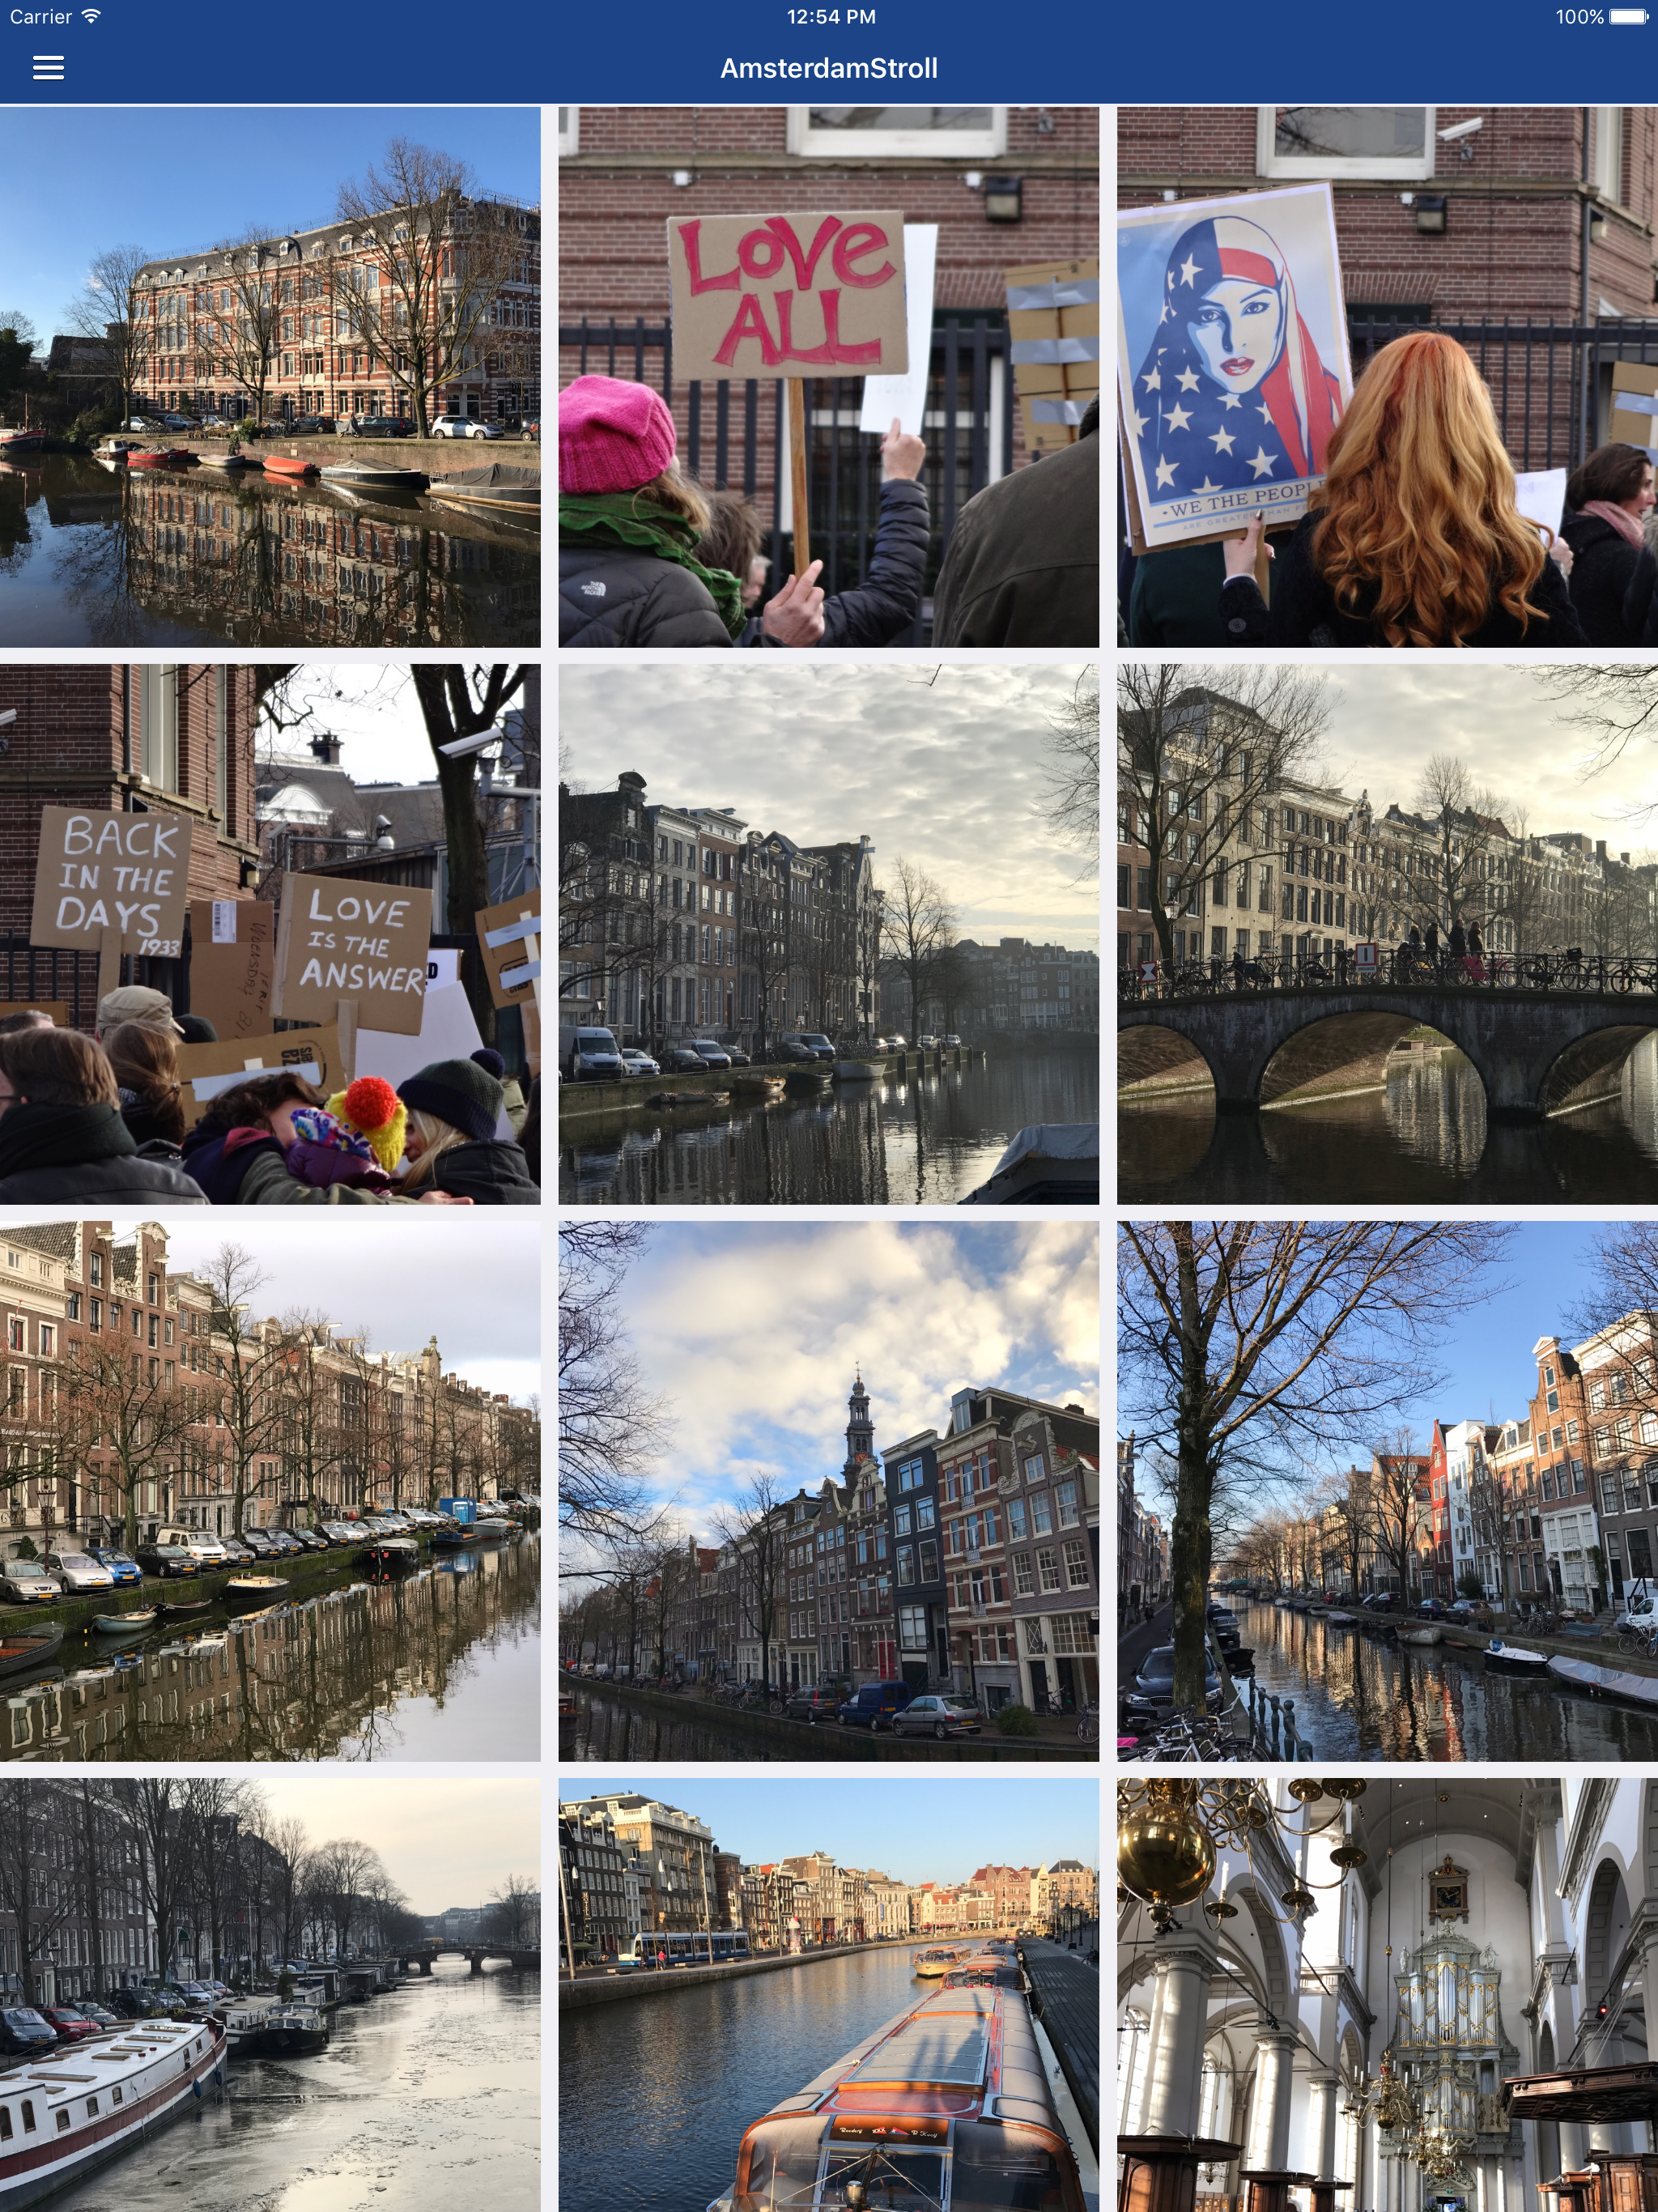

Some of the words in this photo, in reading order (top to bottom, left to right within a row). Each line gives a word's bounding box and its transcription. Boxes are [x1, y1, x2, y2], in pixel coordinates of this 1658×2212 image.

[11, 9, 73, 24] Carrier
[787, 9, 840, 24] 12:54
[847, 9, 877, 24] PM
[1556, 9, 1605, 24] 100%
[721, 57, 937, 79] AmsterdamStroll
[712, 288, 881, 367] ALL
[1170, 500, 1203, 517] WE
[1207, 493, 1248, 510] THE
[1183, 521, 1202, 530] ARE
[1261, 508, 1290, 517] THAN
[1295, 504, 1307, 512] FE
[65, 815, 179, 858] BACK
[58, 862, 100, 889] IN
[113, 867, 173, 896] THE
[56, 896, 160, 938] DAYS
[309, 888, 410, 928] LOVE
[139, 939, 181, 957] 1933
[308, 931, 336, 949] IS
[344, 935, 389, 958] THE
[300, 958, 423, 996] ANSWER
[426, 962, 438, 979] D
